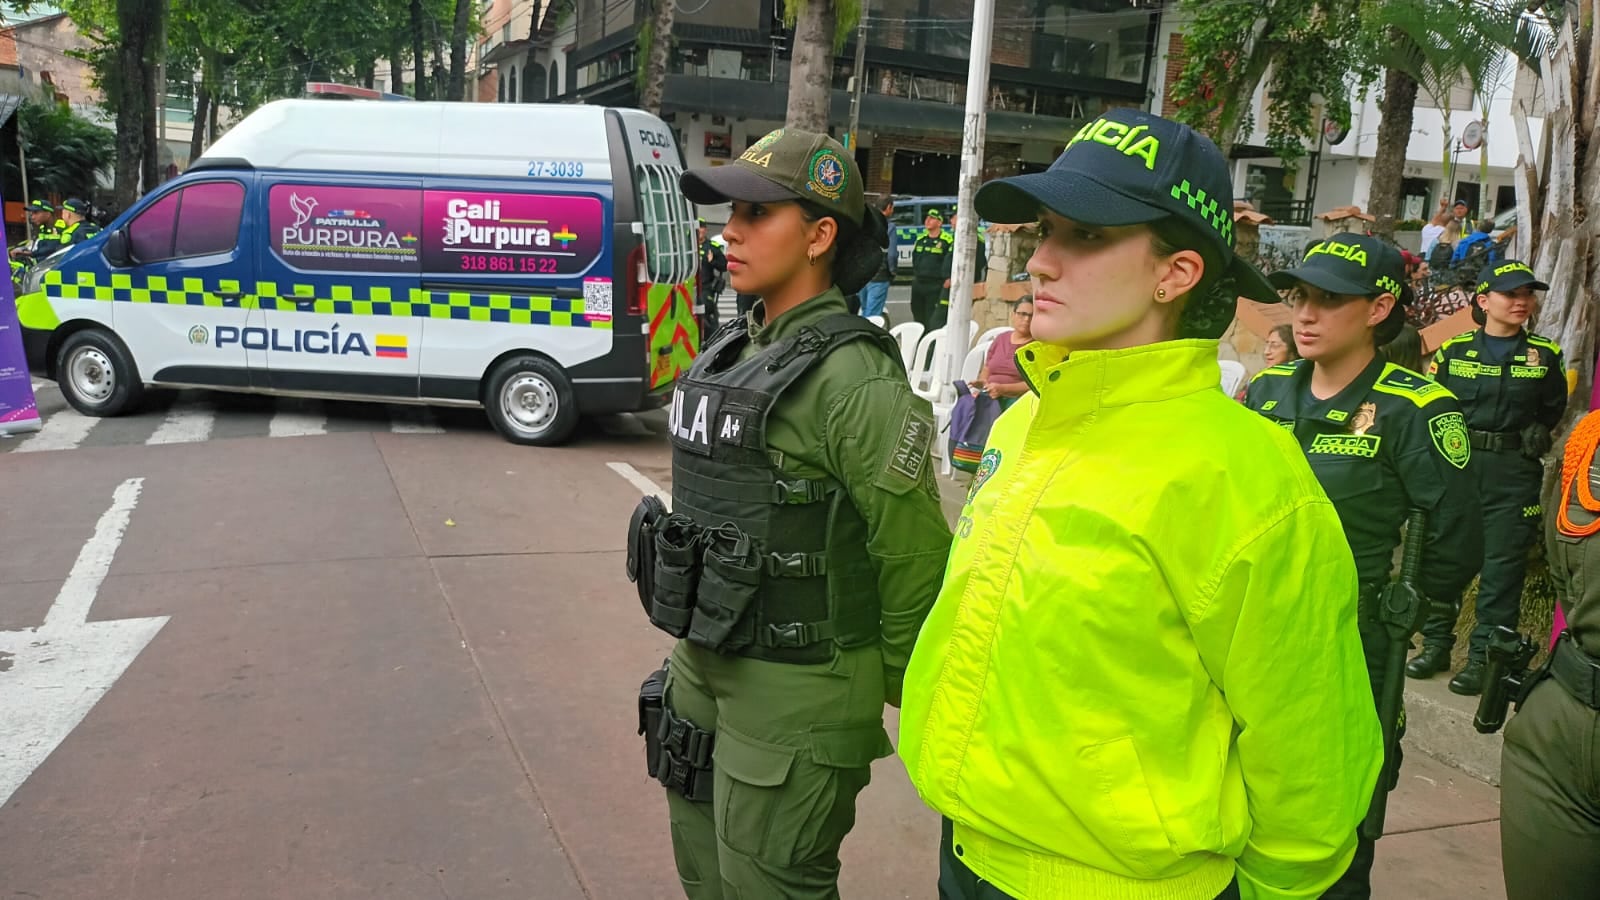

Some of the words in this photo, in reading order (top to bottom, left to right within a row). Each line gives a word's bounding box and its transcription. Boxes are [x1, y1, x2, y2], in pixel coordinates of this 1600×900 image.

[1063, 118, 1160, 170] LICÍA
[527, 161, 584, 177] 27-3039
[740, 151, 773, 168] ULA
[448, 199, 500, 220] Cali
[315, 218, 380, 227] PATRULLA
[461, 255, 487, 270] 318
[489, 256, 515, 271] 861
[520, 257, 536, 272] 15
[539, 258, 557, 273] 22
[1303, 241, 1367, 267] LICÍA
[215, 323, 371, 356] POLICÍA
[669, 386, 709, 445] ULA
[720, 414, 740, 439] A+
[896, 421, 921, 465] ALINA
[1319, 437, 1370, 449] POLICÍA
[906, 451, 922, 471] RH
